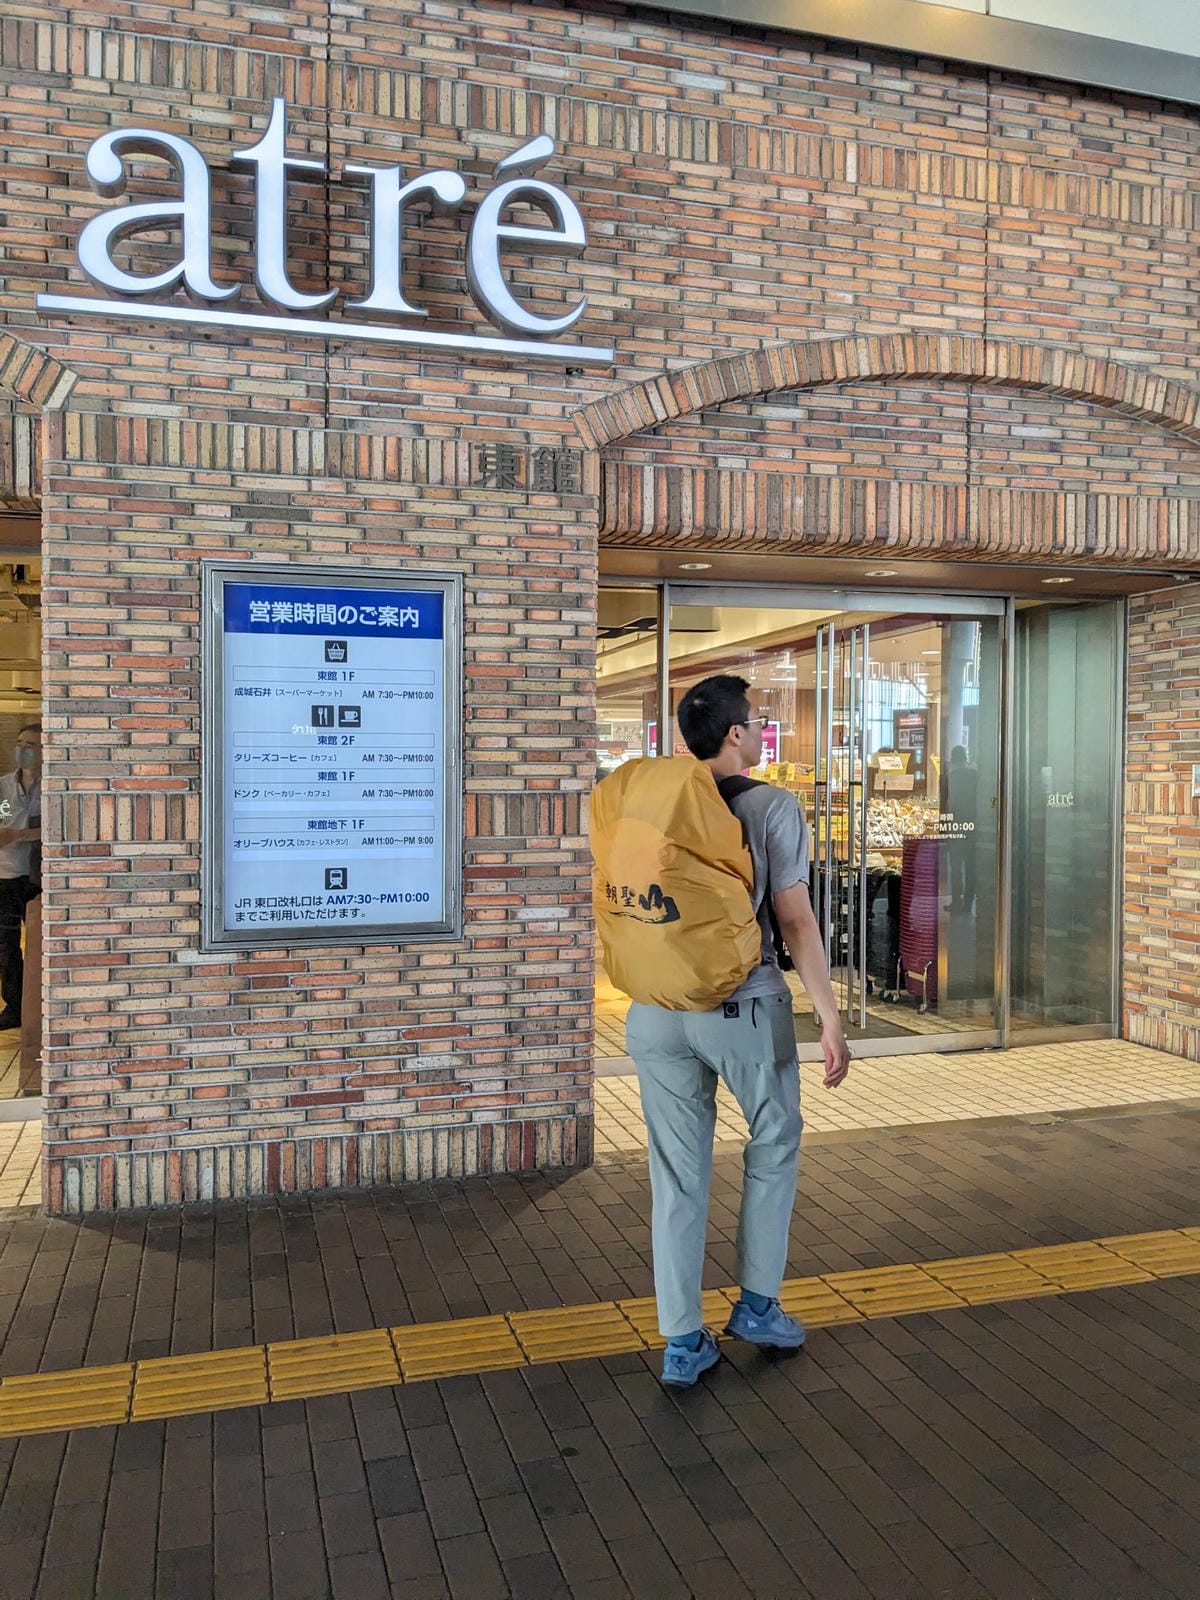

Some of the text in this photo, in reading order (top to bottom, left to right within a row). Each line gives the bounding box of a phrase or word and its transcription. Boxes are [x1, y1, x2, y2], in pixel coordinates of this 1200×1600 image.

[76, 97, 588, 338] atré
[474, 444, 582, 493] 東館
[249, 601, 420, 628] 営業時間のご案内
[317, 671, 355, 682] 東館 1F
[234, 687, 272, 697] 成城石井
[362, 690, 375, 699] AM
[317, 735, 355, 746] 東館 2F
[234, 753, 307, 762] タリーズコーヒー
[362, 754, 375, 762] AM
[317, 771, 355, 781] 東館 1F
[234, 789, 260, 798] ドンク
[362, 789, 375, 798] AM
[1047, 791, 1074, 805] atré
[307, 819, 365, 830] 東館地下 1F
[233, 838, 295, 848] オリーブハウス
[234, 899, 251, 908] JR
[255, 895, 323, 908] 東口改札口は
[235, 908, 367, 923] までご利用いただけます。
